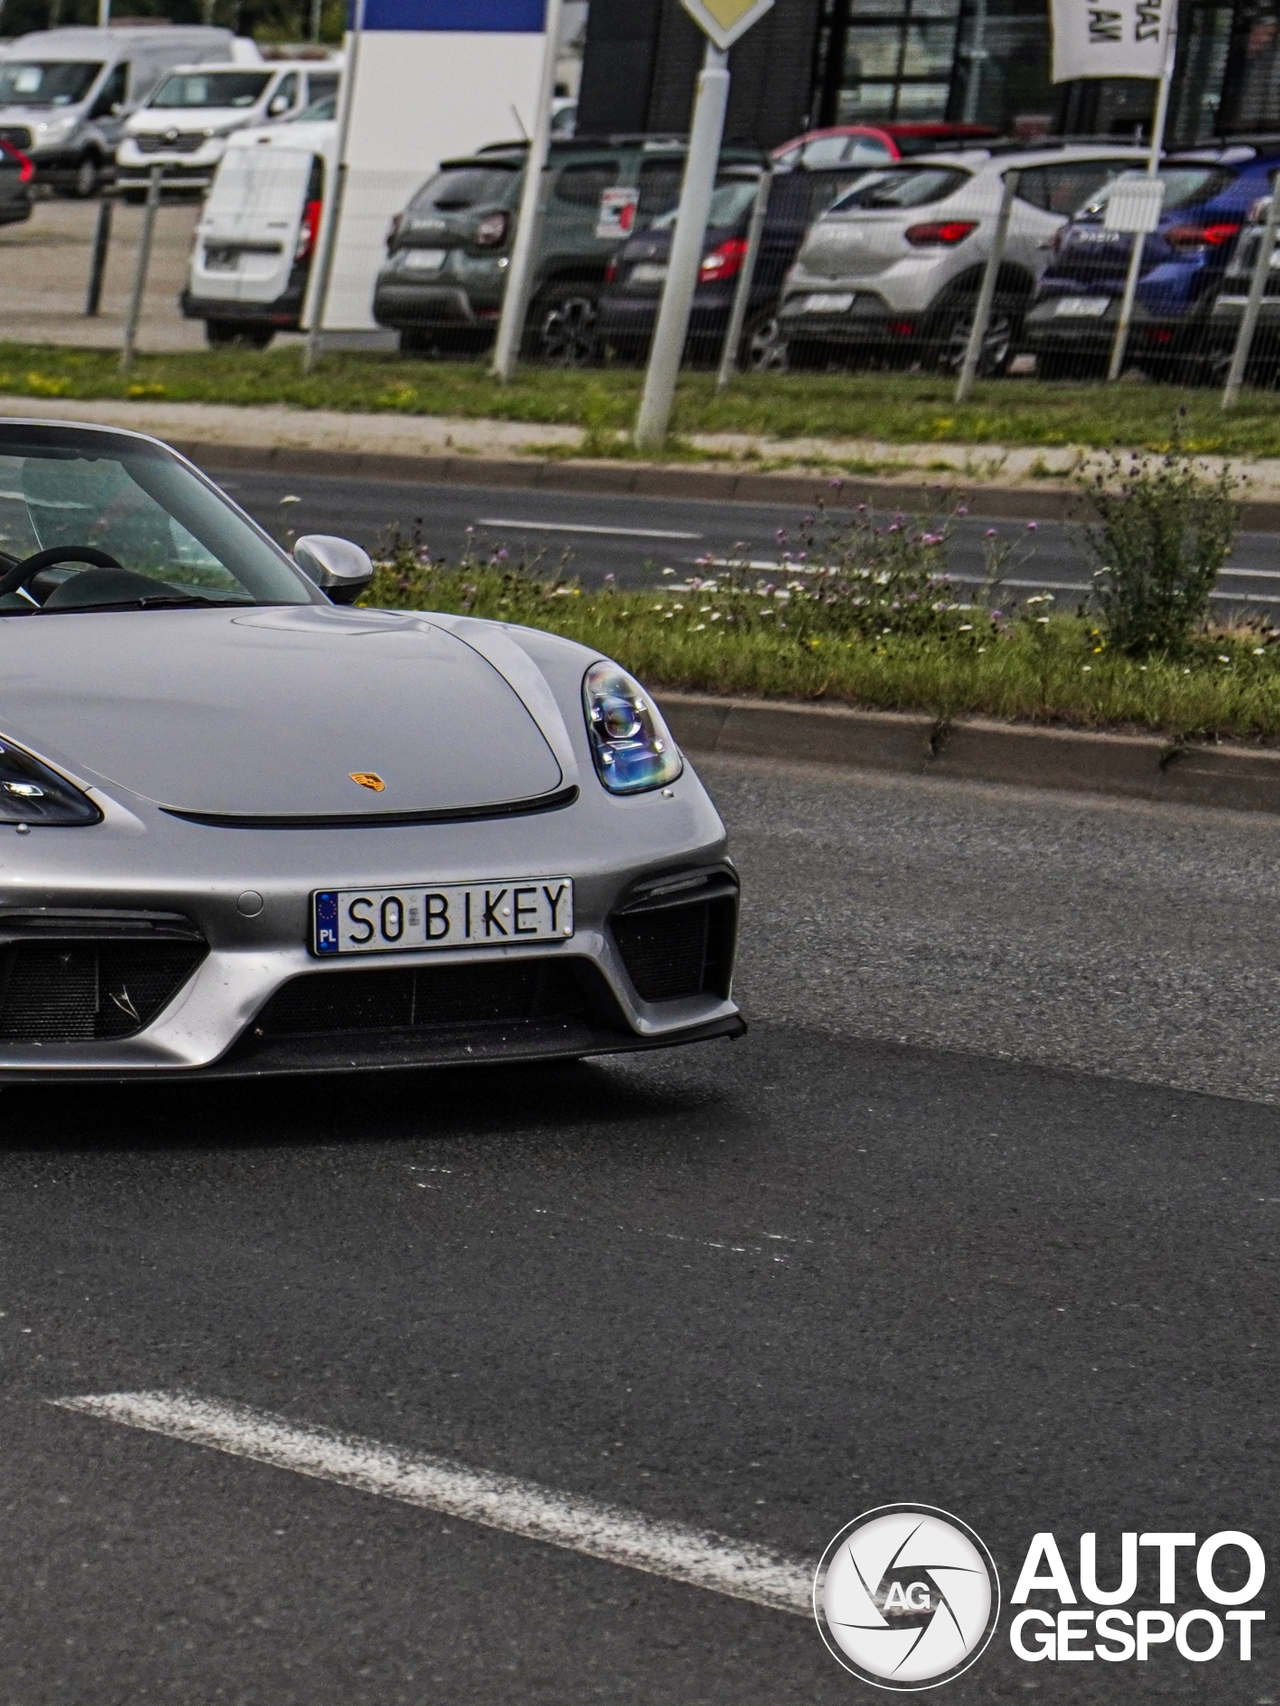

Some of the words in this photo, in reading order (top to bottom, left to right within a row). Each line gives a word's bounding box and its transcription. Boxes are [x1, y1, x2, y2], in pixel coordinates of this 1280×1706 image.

[348, 896, 403, 944] SO
[425, 884, 565, 941] BIKEY
[320, 929, 336, 942] PL
